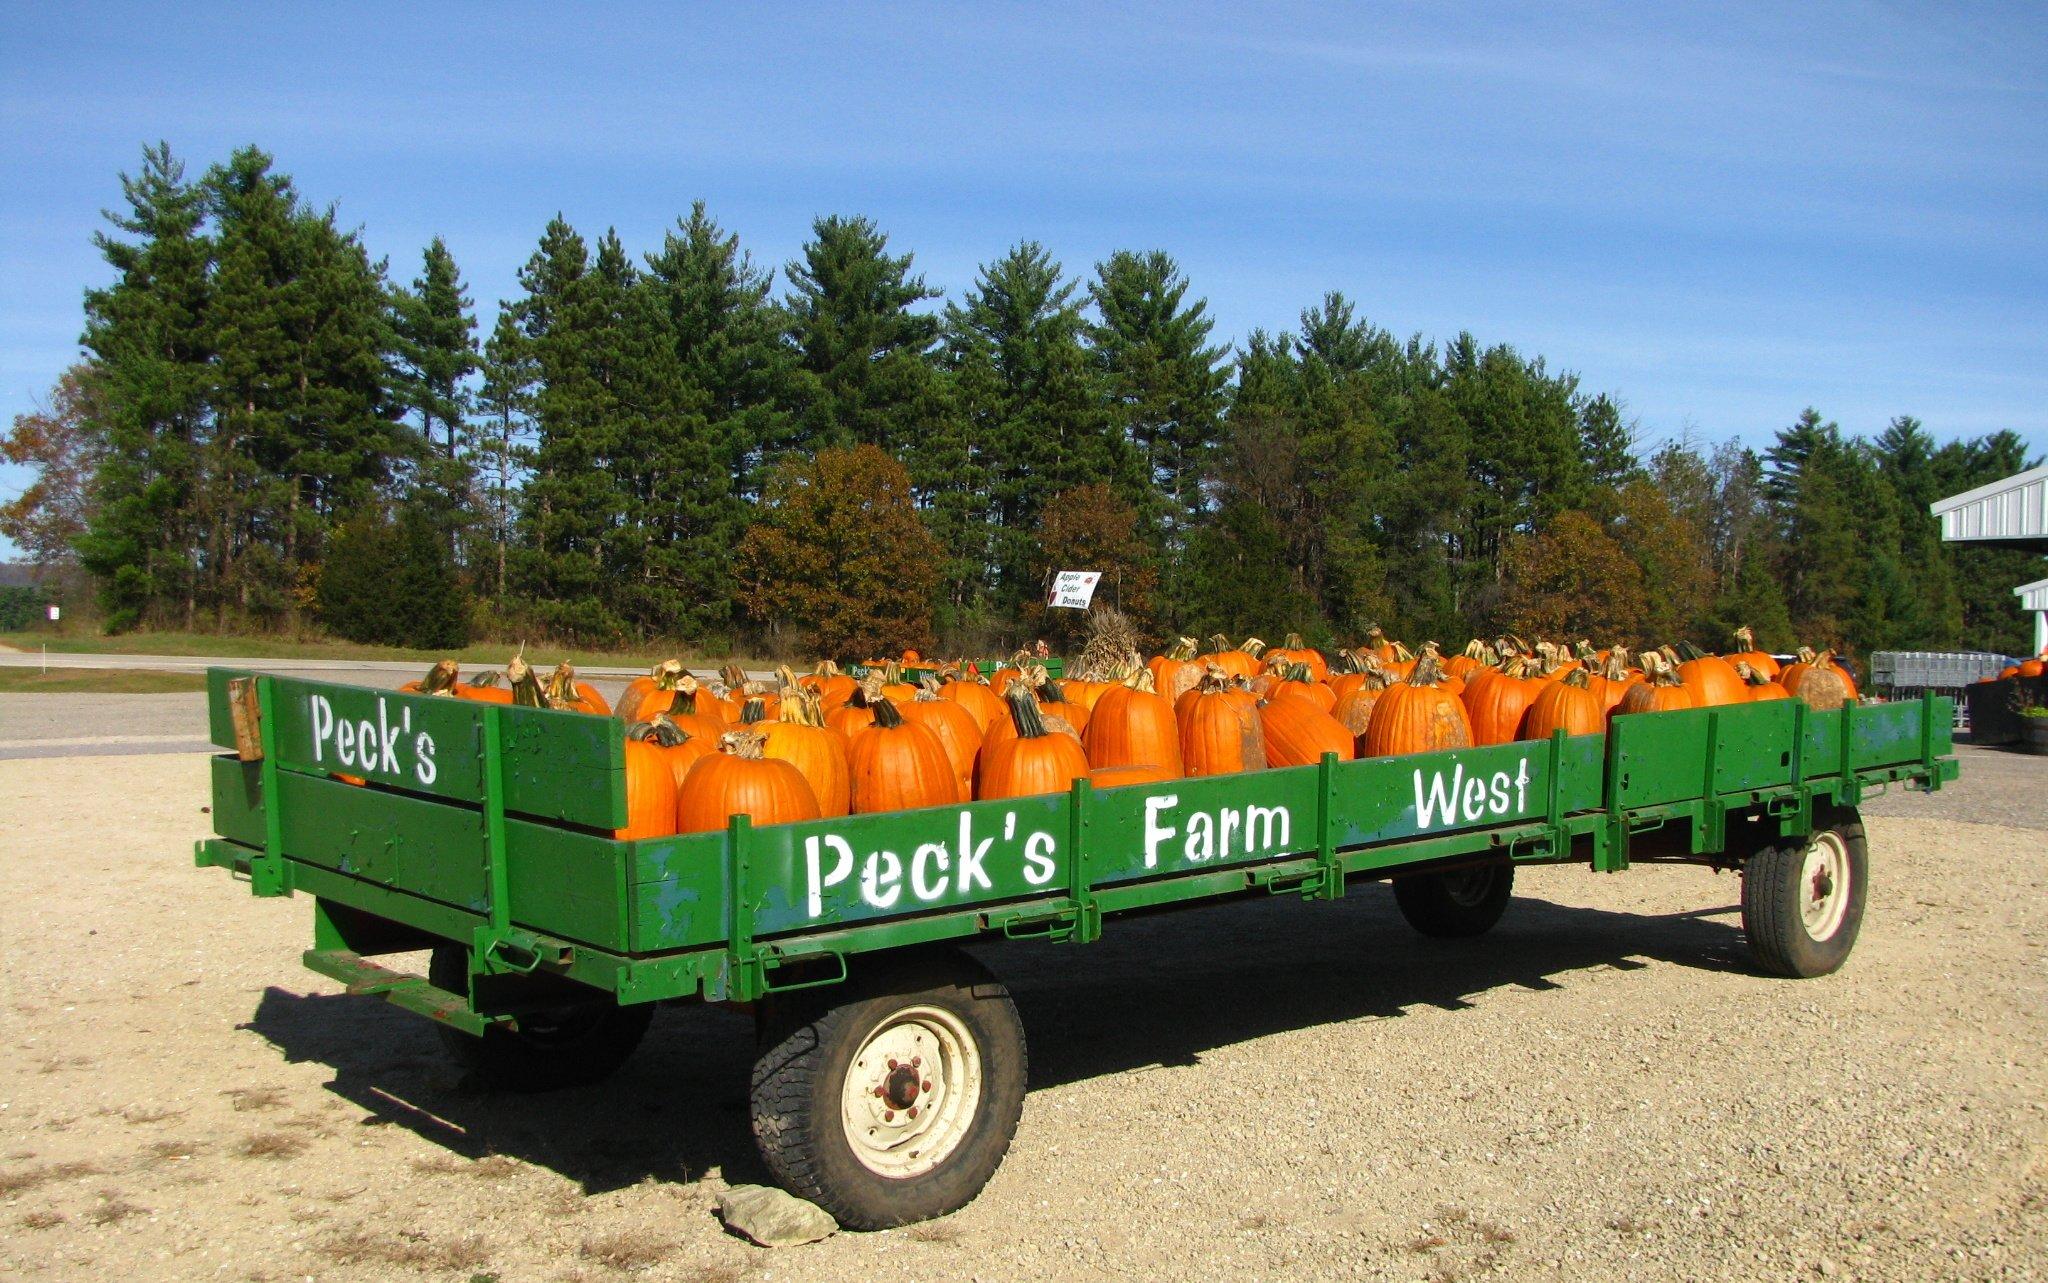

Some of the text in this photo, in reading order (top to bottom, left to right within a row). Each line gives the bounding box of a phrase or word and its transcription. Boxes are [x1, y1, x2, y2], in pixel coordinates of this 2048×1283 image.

[1060, 572, 1081, 583] Apple
[1061, 584, 1080, 593] Cider
[1062, 596, 1087, 606] Donuts
[310, 694, 438, 785] Peck's
[804, 757, 1530, 918] Peck's Farm West
